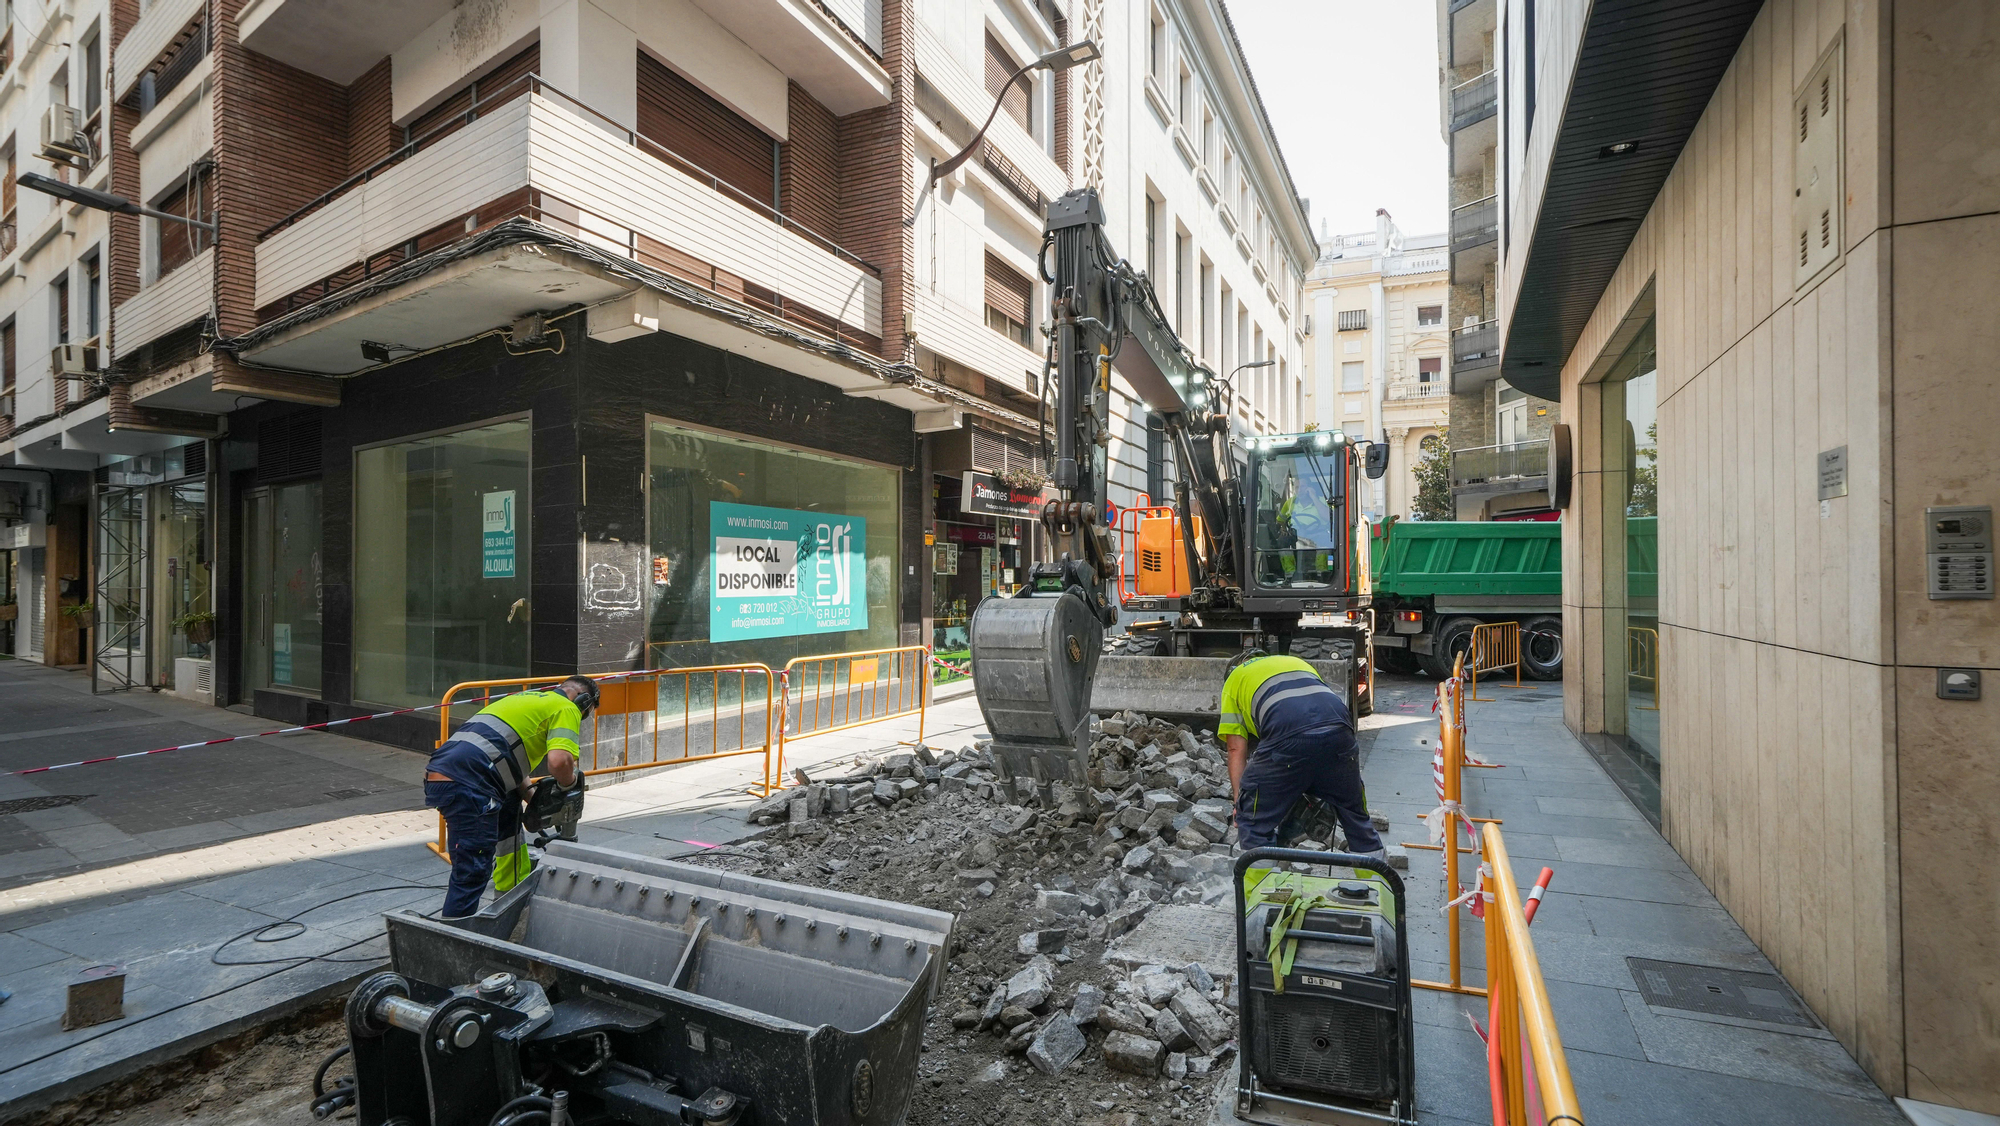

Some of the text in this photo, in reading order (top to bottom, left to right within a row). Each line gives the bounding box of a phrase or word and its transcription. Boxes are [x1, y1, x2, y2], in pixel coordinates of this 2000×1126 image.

[1147, 330, 1178, 375] VOLVO
[975, 485, 1008, 501] Jamones
[727, 516, 789, 531] www.inmosi.com
[485, 538, 494, 548] 693
[495, 537, 505, 547] 344
[736, 545, 781, 563] LOCAL
[485, 559, 514, 572] ALQUILA
[718, 572, 795, 590] DISPONIBLE
[753, 602, 765, 614] 720
[766, 602, 778, 613] 012
[816, 607, 851, 620] GRUPO
[731, 615, 785, 629] info@inmosi.com
[816, 618, 851, 628] INMOBILIARIO
